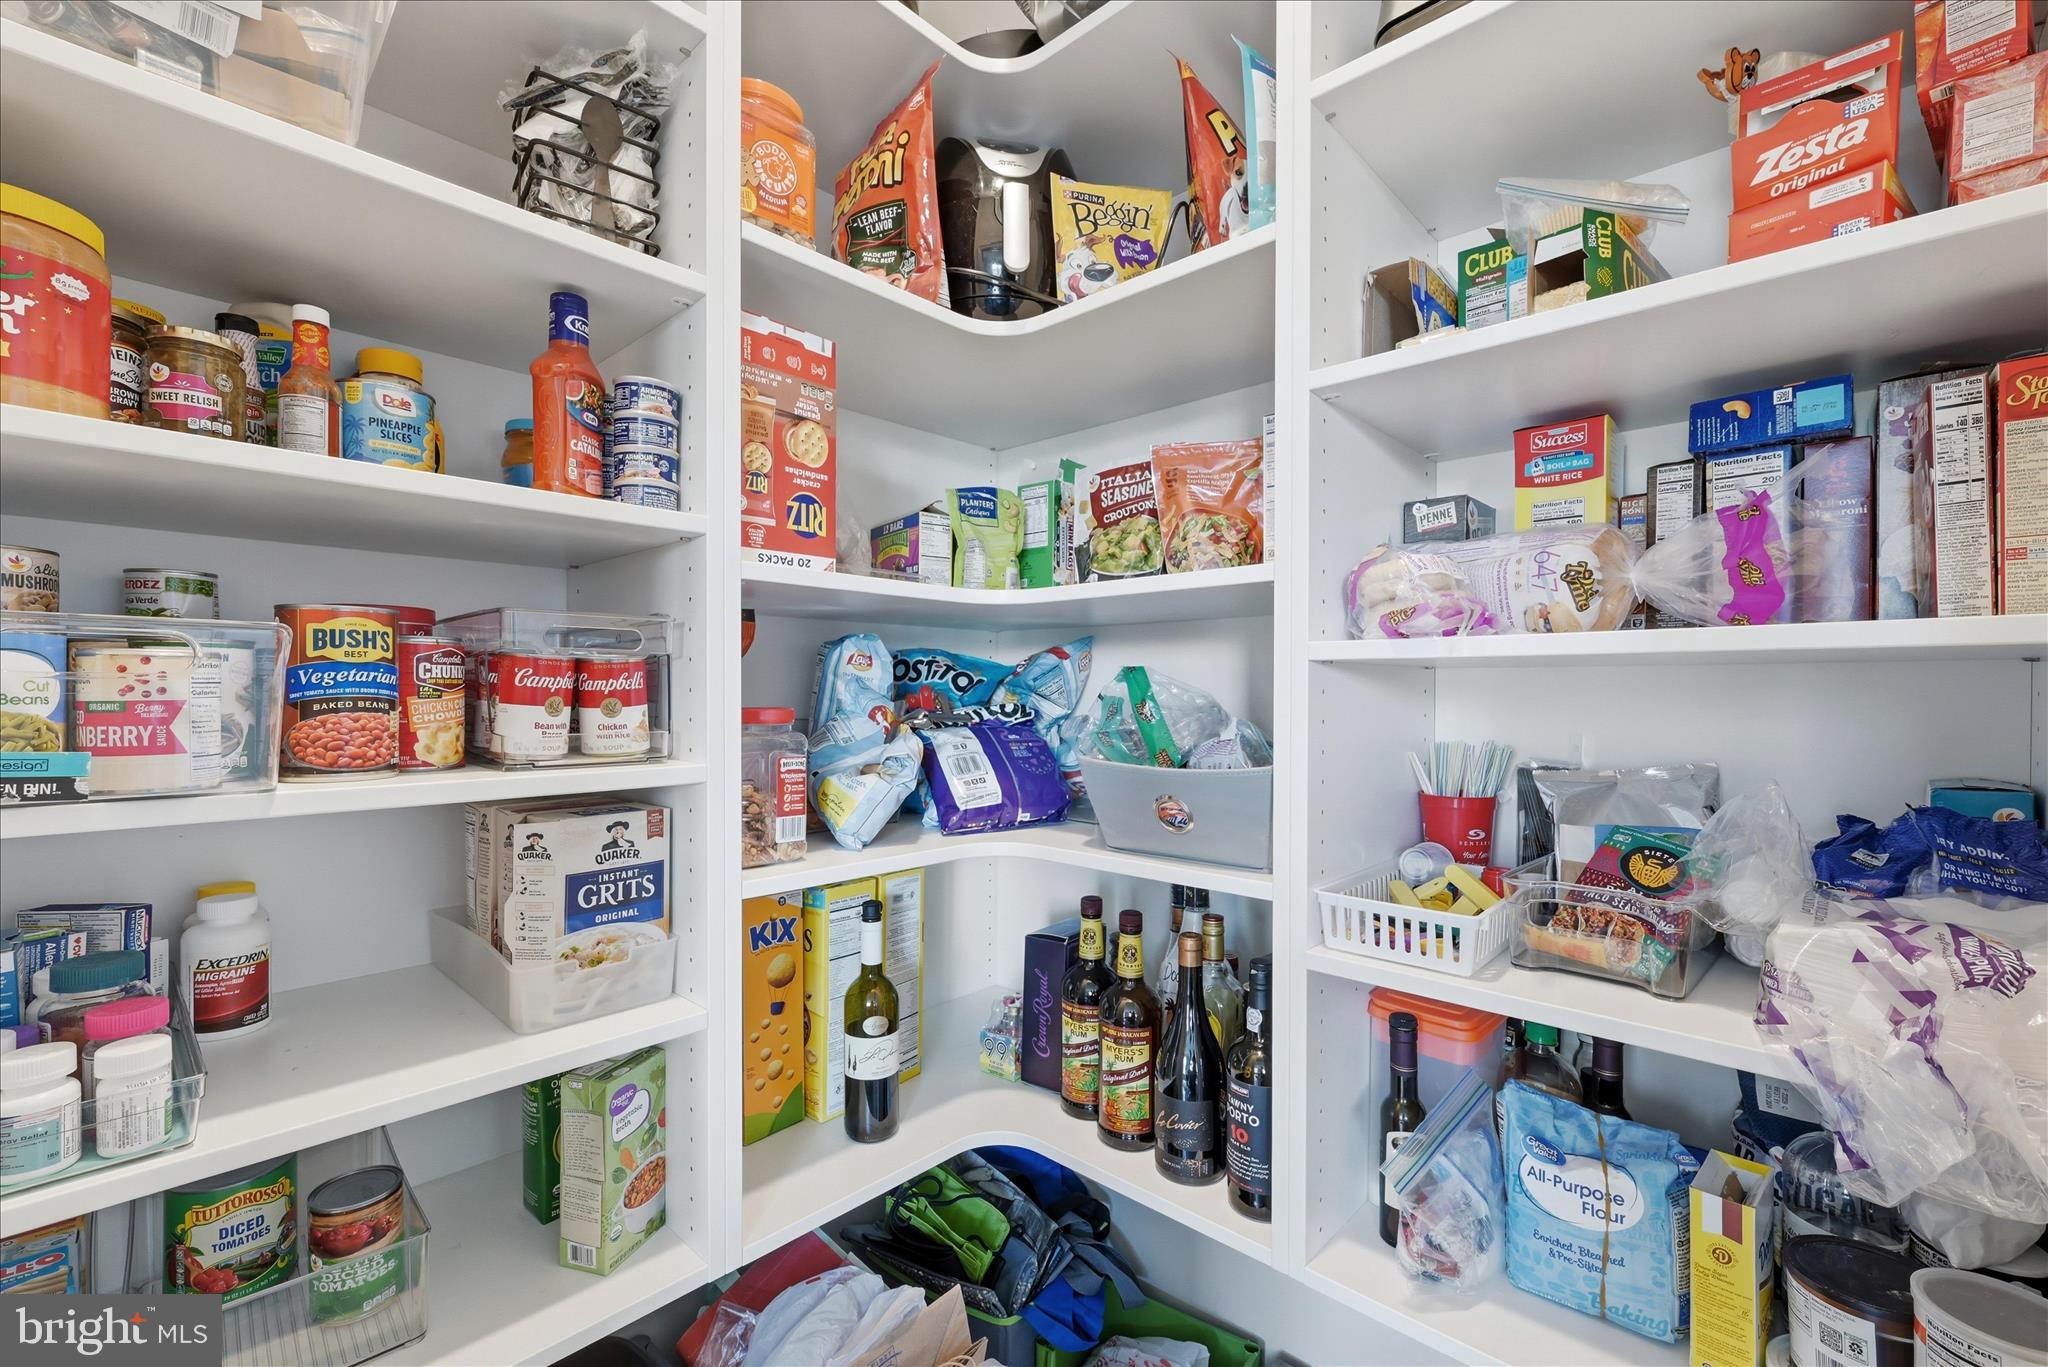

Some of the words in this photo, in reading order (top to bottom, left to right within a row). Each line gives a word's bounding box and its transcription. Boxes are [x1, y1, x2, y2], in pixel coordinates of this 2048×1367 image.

[1852, 103, 1876, 116] USA
[756, 144, 793, 167] BUDDY
[1750, 118, 1869, 187] Zesta
[754, 160, 795, 192] BISCUITS
[1770, 157, 1846, 198] Original
[1073, 192, 1103, 204] PURINA
[858, 210, 878, 228] LEAN
[880, 206, 898, 221] BEEF
[866, 219, 893, 236] FLAVOR
[1596, 217, 1612, 258] CLUB
[1465, 246, 1514, 277] CLUB
[1935, 382, 1962, 391] Nutrition
[1965, 377, 1982, 386] Facts
[150, 391, 179, 401] SWEET
[183, 395, 219, 408] RELISH
[382, 394, 412, 410] Dole
[368, 417, 421, 436] PINEAPPLE
[380, 429, 412, 444] SLICES
[1533, 431, 1584, 449] Success
[1572, 458, 1590, 466] BAG
[1714, 457, 1754, 468] Nutrition
[1755, 453, 1783, 462] Facts
[785, 466, 829, 481] sandwiches
[1534, 474, 1560, 484] WHITE
[1562, 472, 1583, 480] RICE
[1658, 466, 1678, 474] Nutrition
[746, 475, 769, 494] RITZ
[793, 478, 821, 489] cracker
[960, 498, 994, 510] PLANTERS
[1622, 507, 1644, 515] RONI
[786, 500, 827, 538] RITZ
[1420, 507, 1453, 525] PENNE
[758, 553, 794, 567] PACKS
[797, 557, 811, 569] 20
[134, 596, 158, 604] Verde
[313, 628, 391, 653] BUSH'S
[23, 680, 50, 692] Cut
[298, 668, 397, 687] Vegetarian
[578, 671, 644, 695] Campbell's
[88, 703, 120, 711] ORGANIC
[313, 701, 353, 711] BAKED
[357, 701, 389, 710] BEANS
[412, 701, 453, 715] CHICKEN
[534, 722, 556, 730] Bean
[597, 723, 628, 731] Chicken
[156, 725, 167, 746] SAUCE
[24, 783, 58, 796] BIN!
[517, 851, 552, 861] QUAKER
[595, 849, 641, 866] QUAKER
[1644, 849, 1675, 863] SIETE
[599, 868, 639, 882] INSTANT
[1944, 863, 1957, 873] OR
[577, 874, 656, 909] GRITS
[1965, 875, 2001, 889] YOU'VE
[2004, 883, 2029, 894] GOT!
[595, 908, 639, 923] ORIGINAL
[73, 946, 81, 957] CV
[195, 948, 269, 970] EXCEDRIN
[194, 965, 257, 982] MIGRAINE
[1033, 968, 1053, 1024] Royal
[1064, 1019, 1097, 1032] MYERS'S
[1070, 1029, 1088, 1038] RUM
[1031, 1014, 1050, 1058] Crown
[983, 1038, 1007, 1058] 99
[1106, 1044, 1145, 1056] MYERS'S
[1114, 1054, 1134, 1063] RUM
[1103, 1071, 1128, 1084] Original
[1129, 1066, 1149, 1079] Dark
[1227, 1093, 1255, 1113] TAWNY
[1230, 1123, 1249, 1145] 10
[1526, 1135, 1557, 1158] Great
[1533, 1146, 1558, 1162] Value
[1527, 1165, 1626, 1207] All-Purpose
[192, 1182, 286, 1223] TUTTOROSSO
[1581, 1202, 1627, 1225] Flour
[219, 1214, 265, 1241] DICED
[211, 1225, 271, 1254] TOMATOES
[1533, 1229, 1577, 1254] Enriched,
[1577, 1245, 1626, 1268] Bleahed
[313, 1259, 397, 1293] TOMATOES
[321, 1258, 385, 1282] DICED
[1927, 1318, 1964, 1347] Nutrition
[1966, 1343, 1999, 1363] Facts
